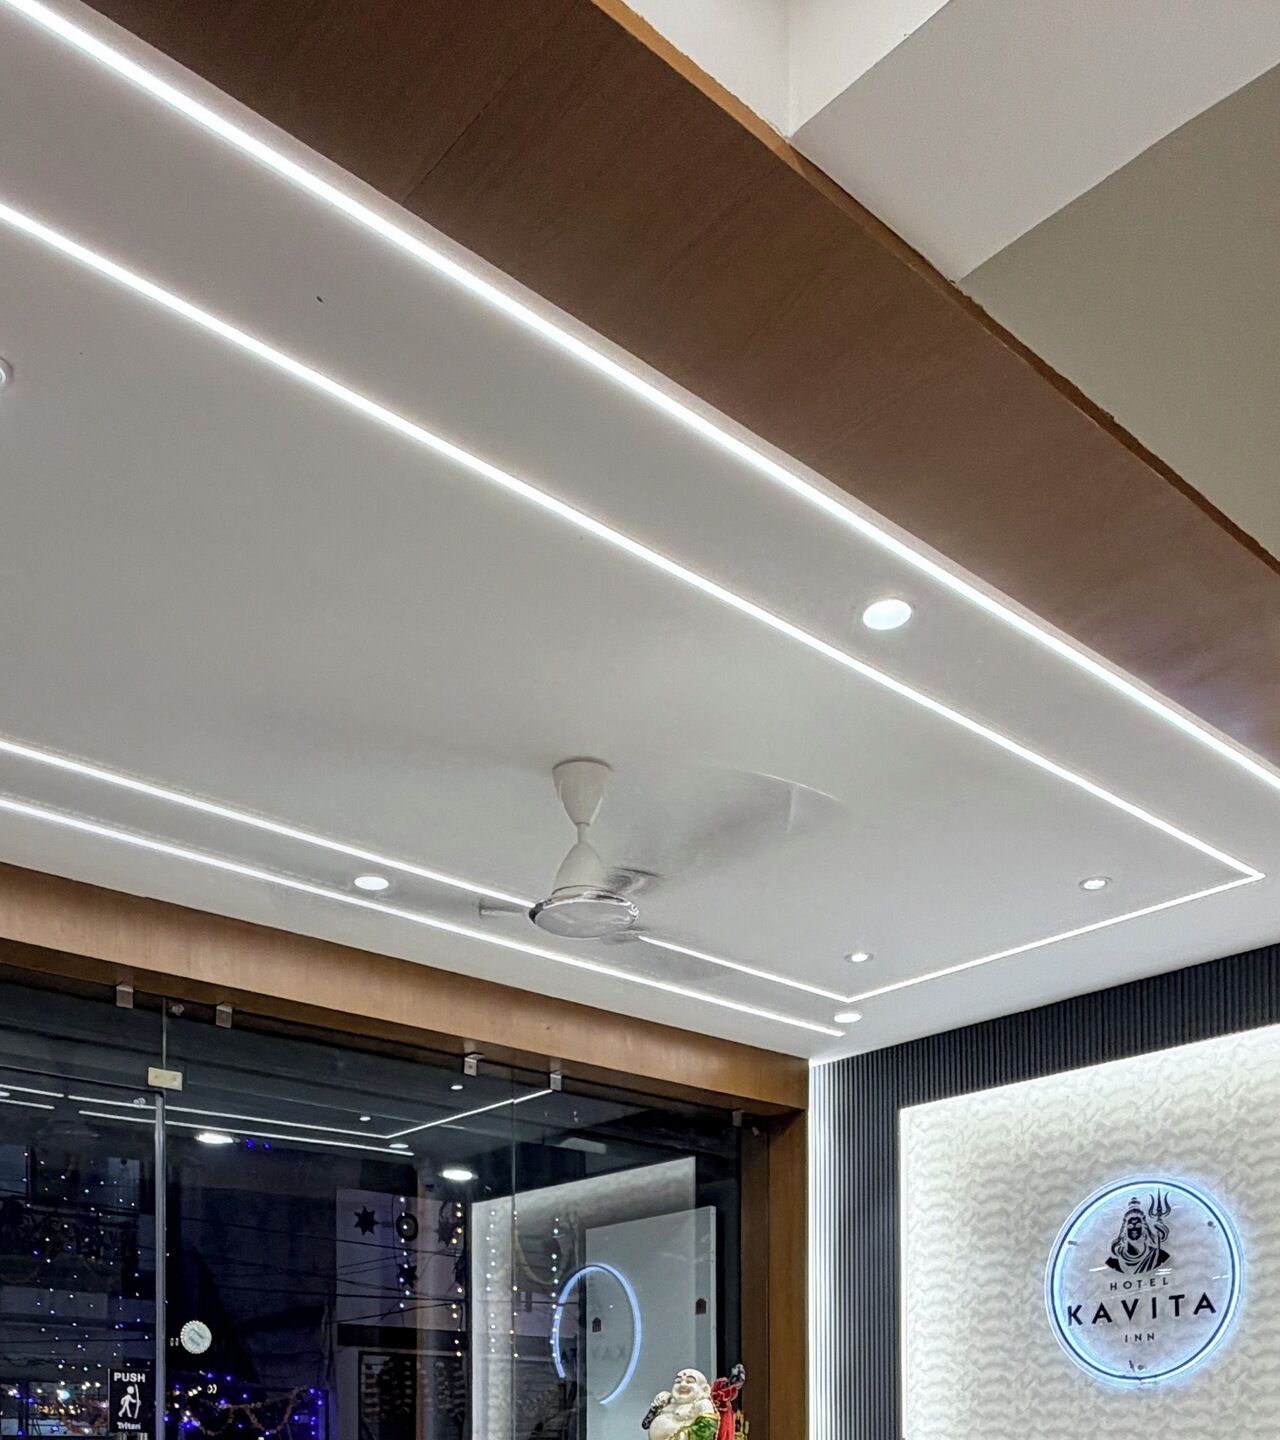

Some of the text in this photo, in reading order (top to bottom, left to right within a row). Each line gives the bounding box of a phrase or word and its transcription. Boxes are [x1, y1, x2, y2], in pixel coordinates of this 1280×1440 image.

[1109, 1276, 1170, 1291] HOTEL
[1066, 1291, 1217, 1327] KAVITA
[1124, 1332, 1156, 1343] INN
[113, 1371, 146, 1383] PUSH
